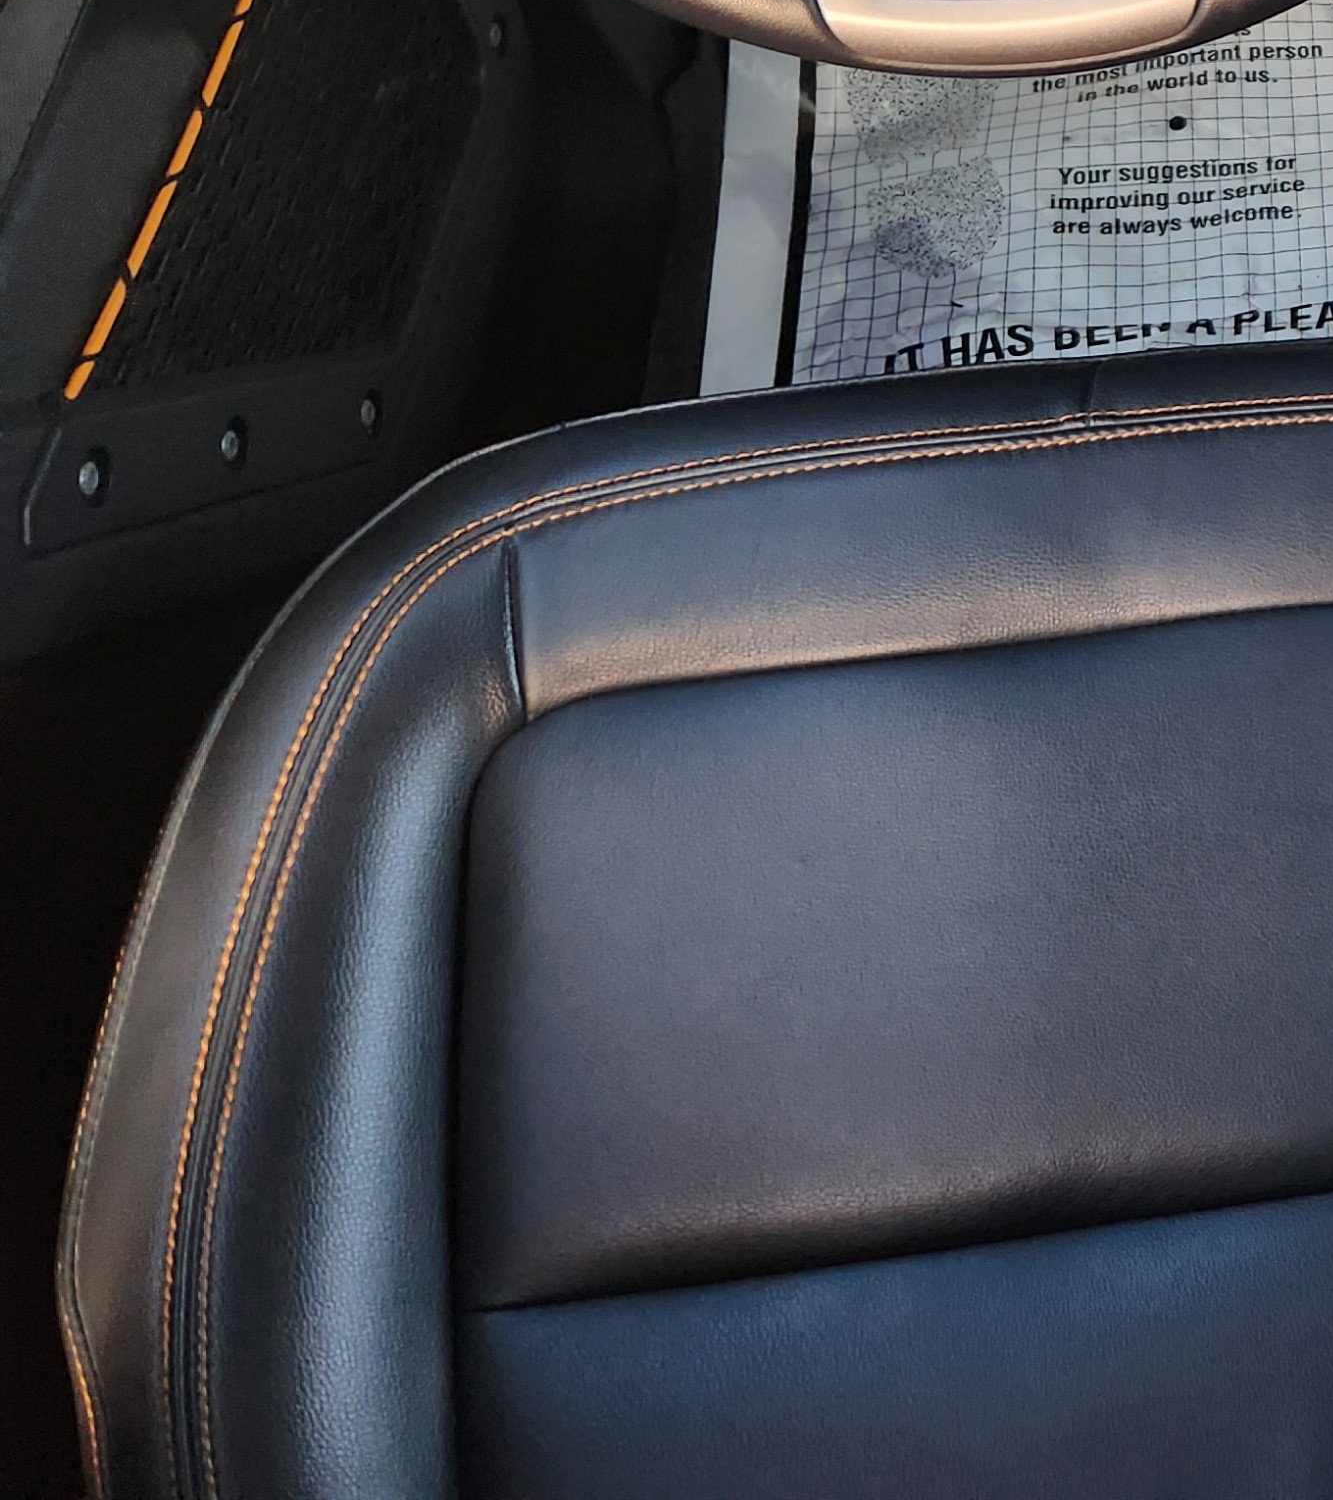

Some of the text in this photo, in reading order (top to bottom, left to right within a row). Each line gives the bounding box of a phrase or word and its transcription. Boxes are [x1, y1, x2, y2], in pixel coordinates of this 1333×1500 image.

[1032, 75, 1067, 94] the
[1249, 43, 1323, 62] person
[1077, 68, 1279, 104] in the world to us.
[1058, 156, 1297, 186] Your suggestions for
[1050, 178, 1306, 214] improving our service
[1053, 204, 1303, 237] are always welcome.
[941, 324, 1035, 368] HAS
